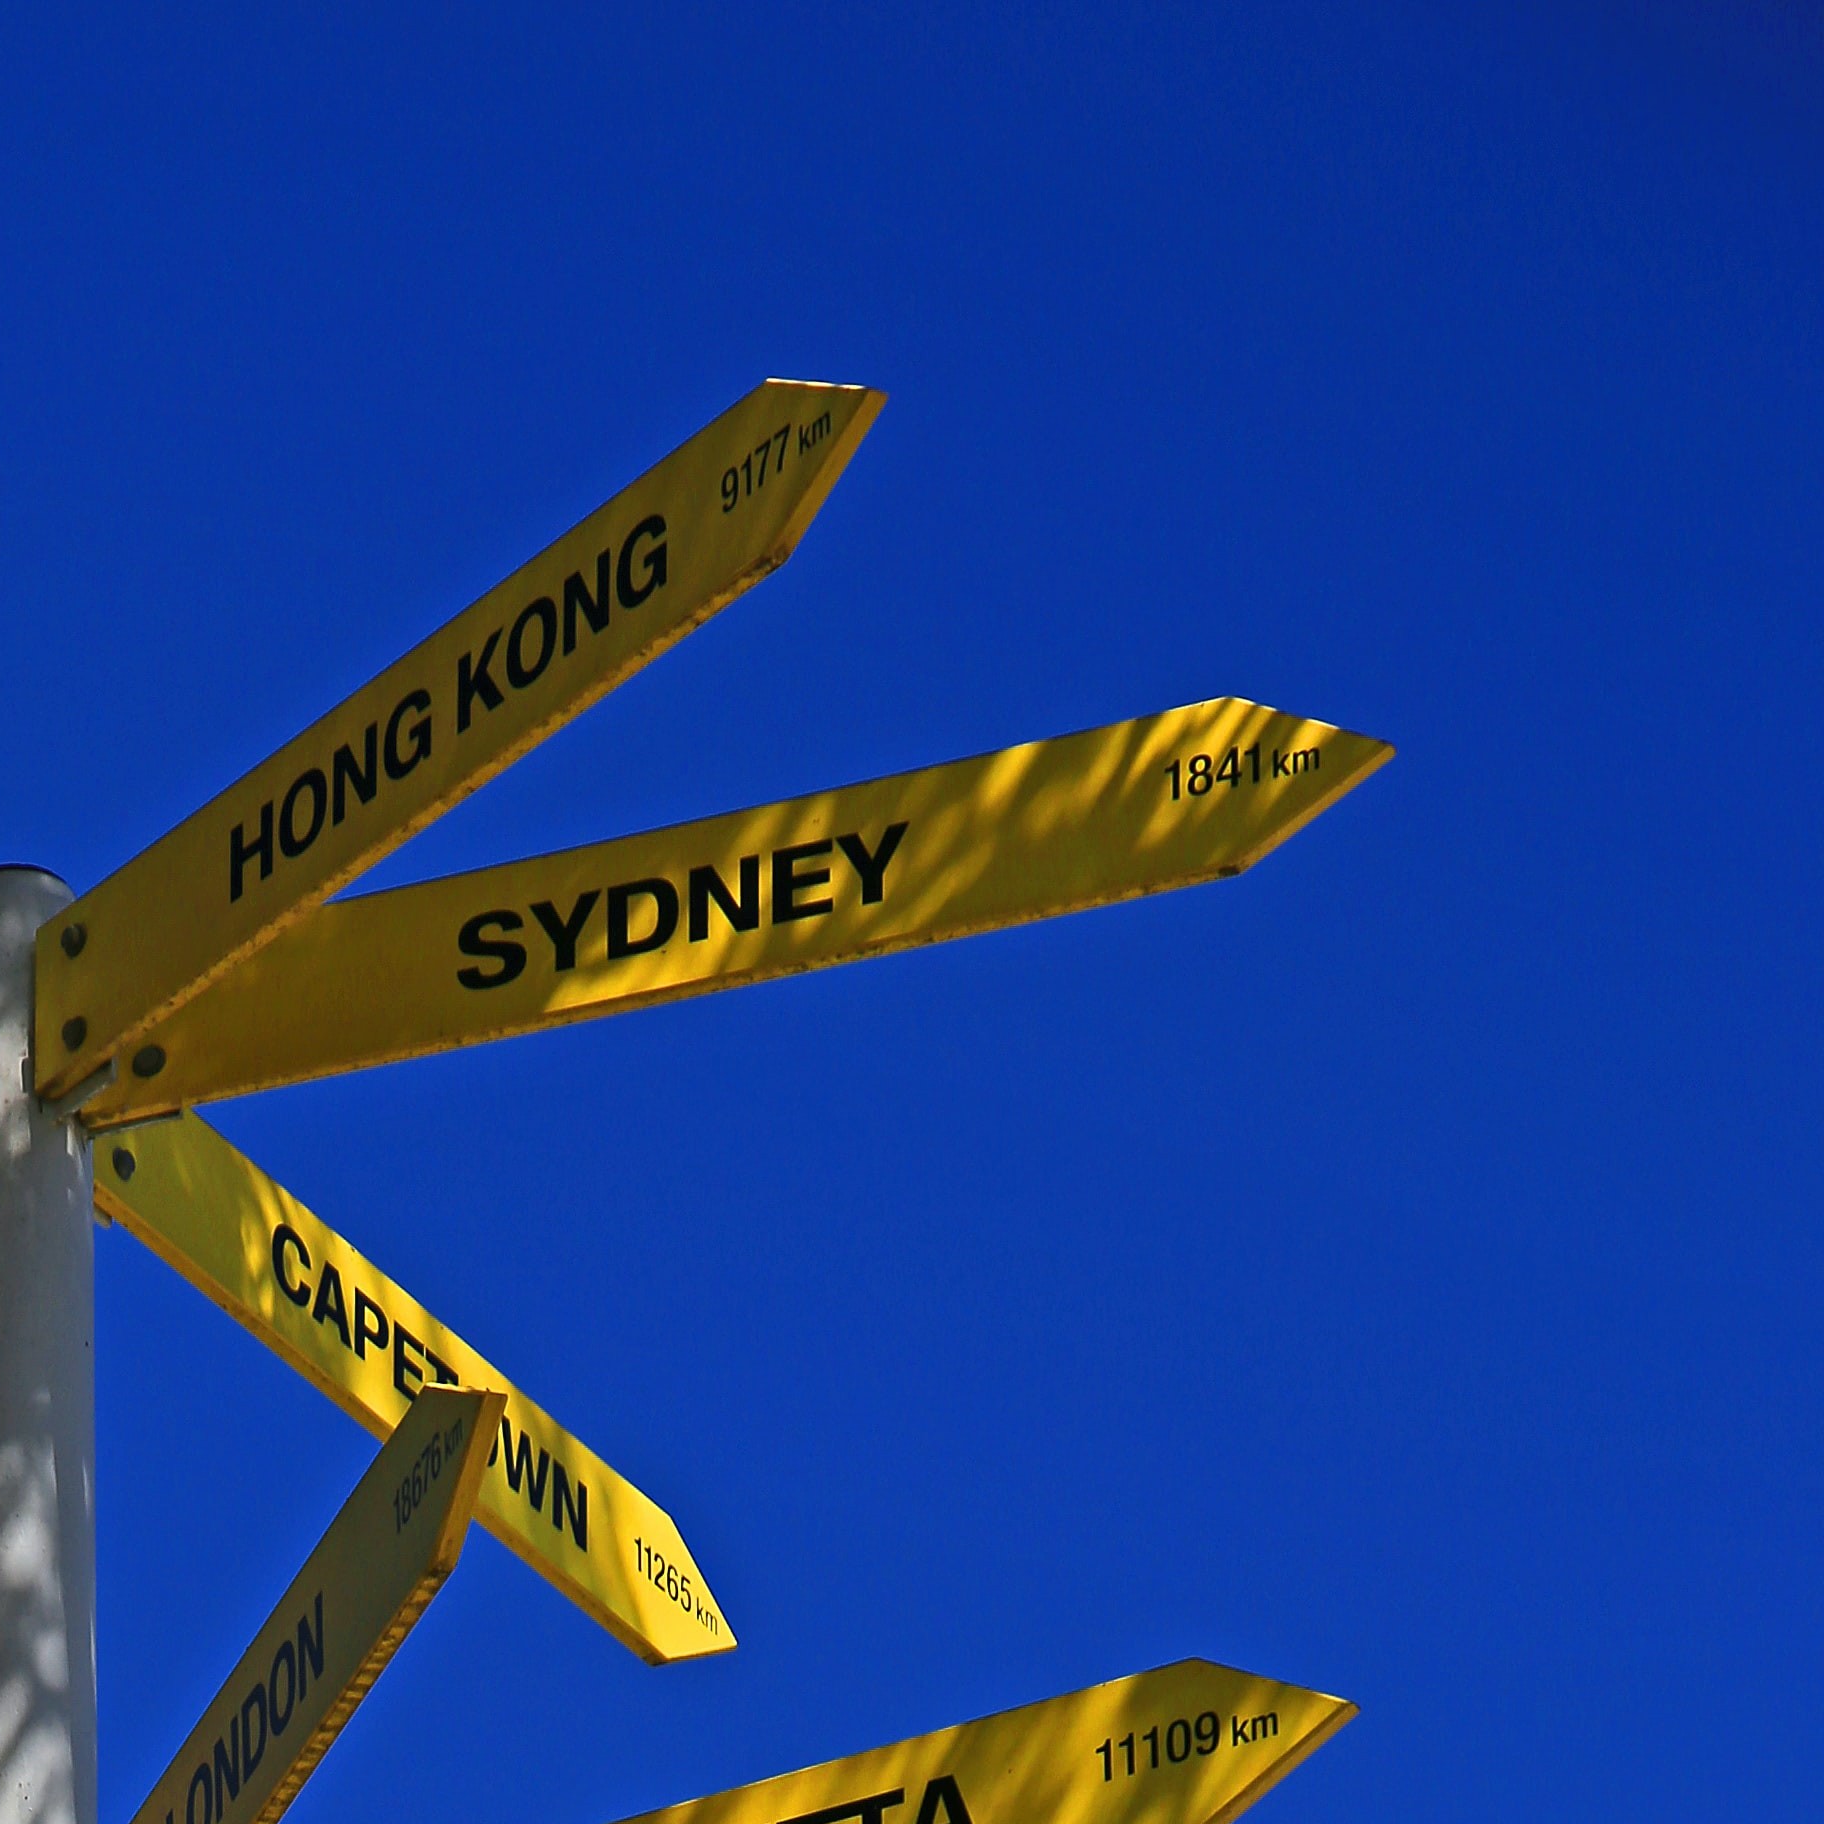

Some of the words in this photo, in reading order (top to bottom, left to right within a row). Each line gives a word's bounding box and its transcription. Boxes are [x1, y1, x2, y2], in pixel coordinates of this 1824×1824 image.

[721, 423, 791, 513] 9177
[799, 411, 831, 455] km
[228, 687, 433, 901] HONG
[456, 513, 668, 736] KONG
[1164, 742, 1261, 801] 1841
[1272, 747, 1321, 779] km
[457, 822, 908, 992] SYDNEY
[271, 1223, 589, 1553] CAPEWN
[634, 1536, 692, 1614] 11265
[695, 1596, 719, 1636] km
[1096, 1711, 1221, 1783] 11109
[1231, 1707, 1280, 1747] km
